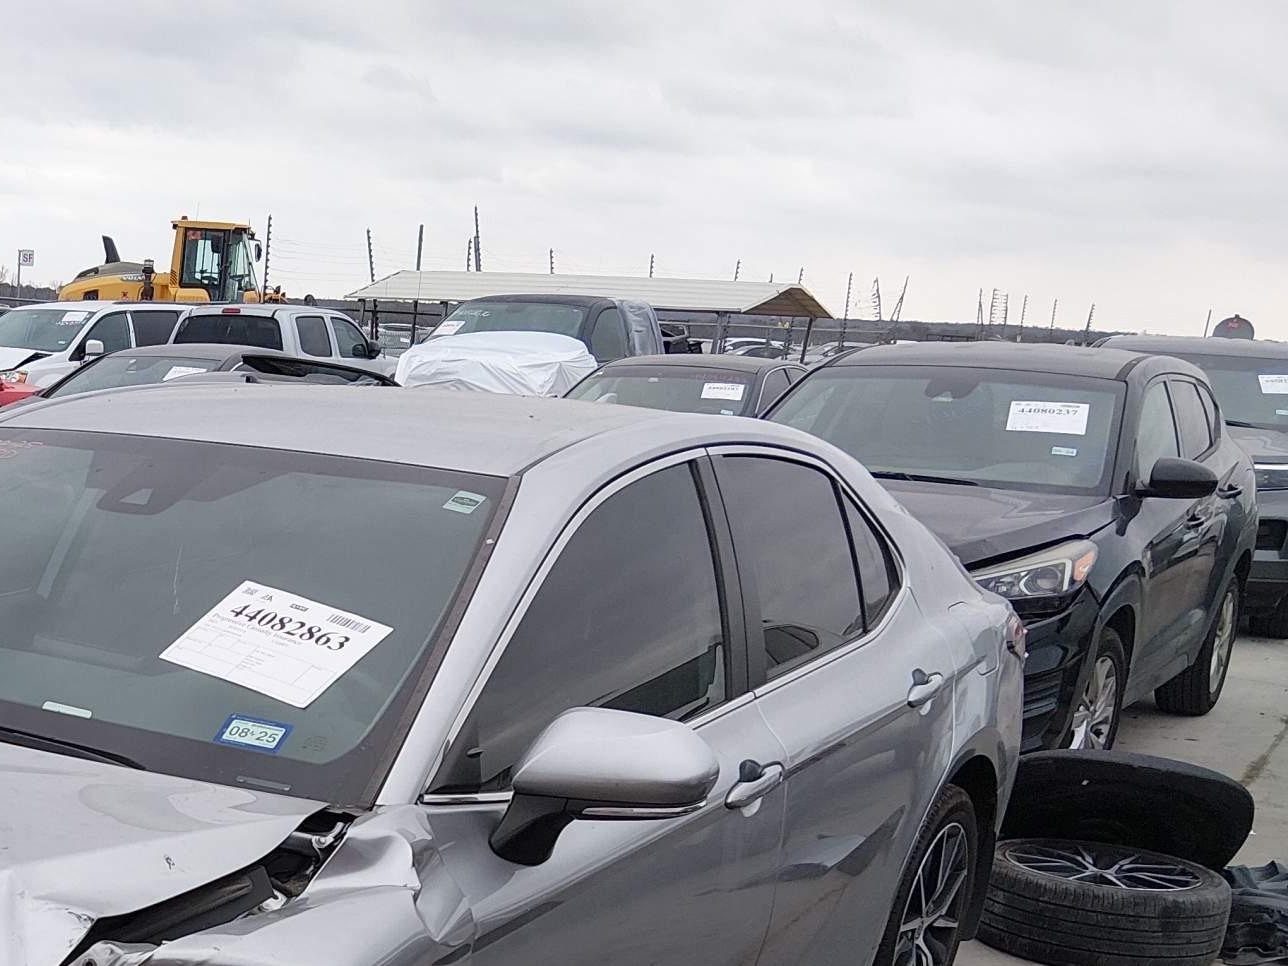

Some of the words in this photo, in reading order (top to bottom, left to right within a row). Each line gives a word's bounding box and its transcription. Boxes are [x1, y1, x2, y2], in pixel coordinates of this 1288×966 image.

[23, 253, 33, 263] SF
[230, 604, 350, 650] 44082863
[229, 725, 250, 738] 08
[256, 730, 279, 744] 25
